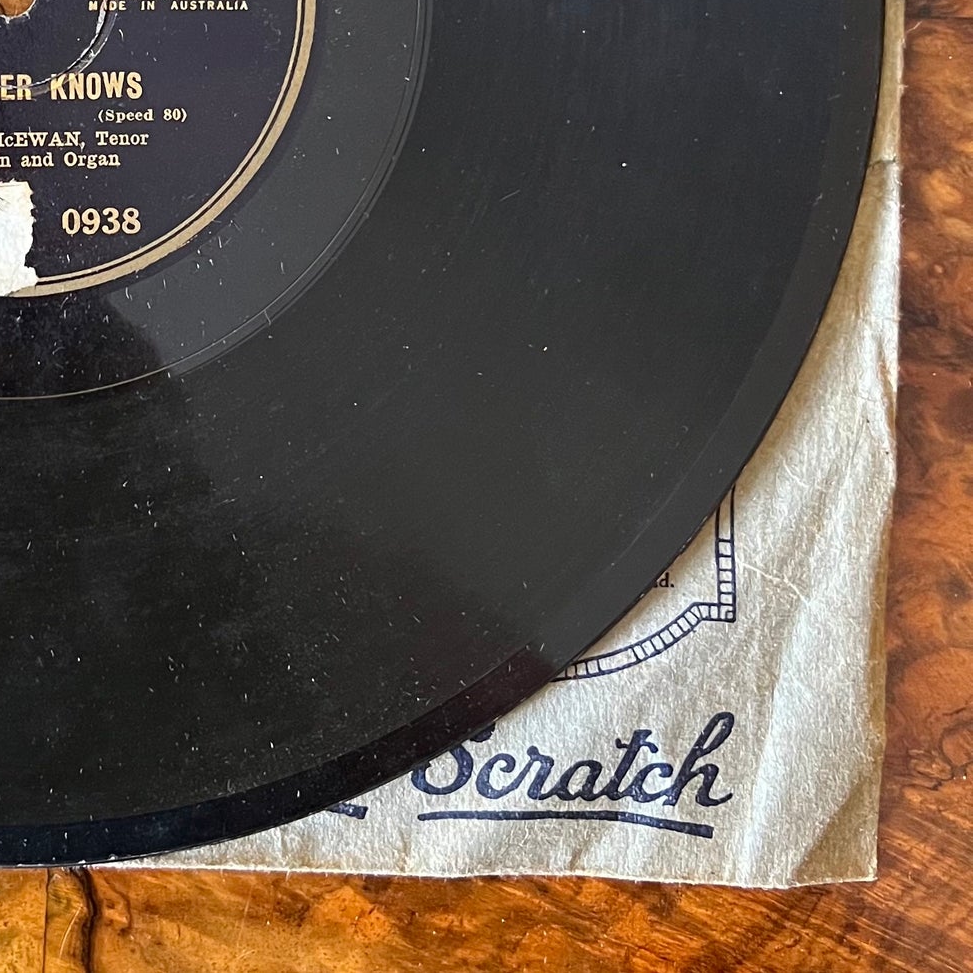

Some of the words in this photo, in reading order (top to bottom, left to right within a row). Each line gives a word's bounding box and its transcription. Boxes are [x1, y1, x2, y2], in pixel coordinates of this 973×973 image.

[141, 0, 155, 10] IN
[170, 0, 249, 10] AUSTRALIA
[51, 71, 144, 100] KNOWS
[97, 109, 154, 123] (Speed
[163, 108, 187, 122] 80)
[96, 131, 149, 147] Tenor
[20, 152, 54, 167] and
[64, 152, 121, 168] Organ
[62, 207, 142, 235] 0938
[411, 711, 734, 807] Scratch
